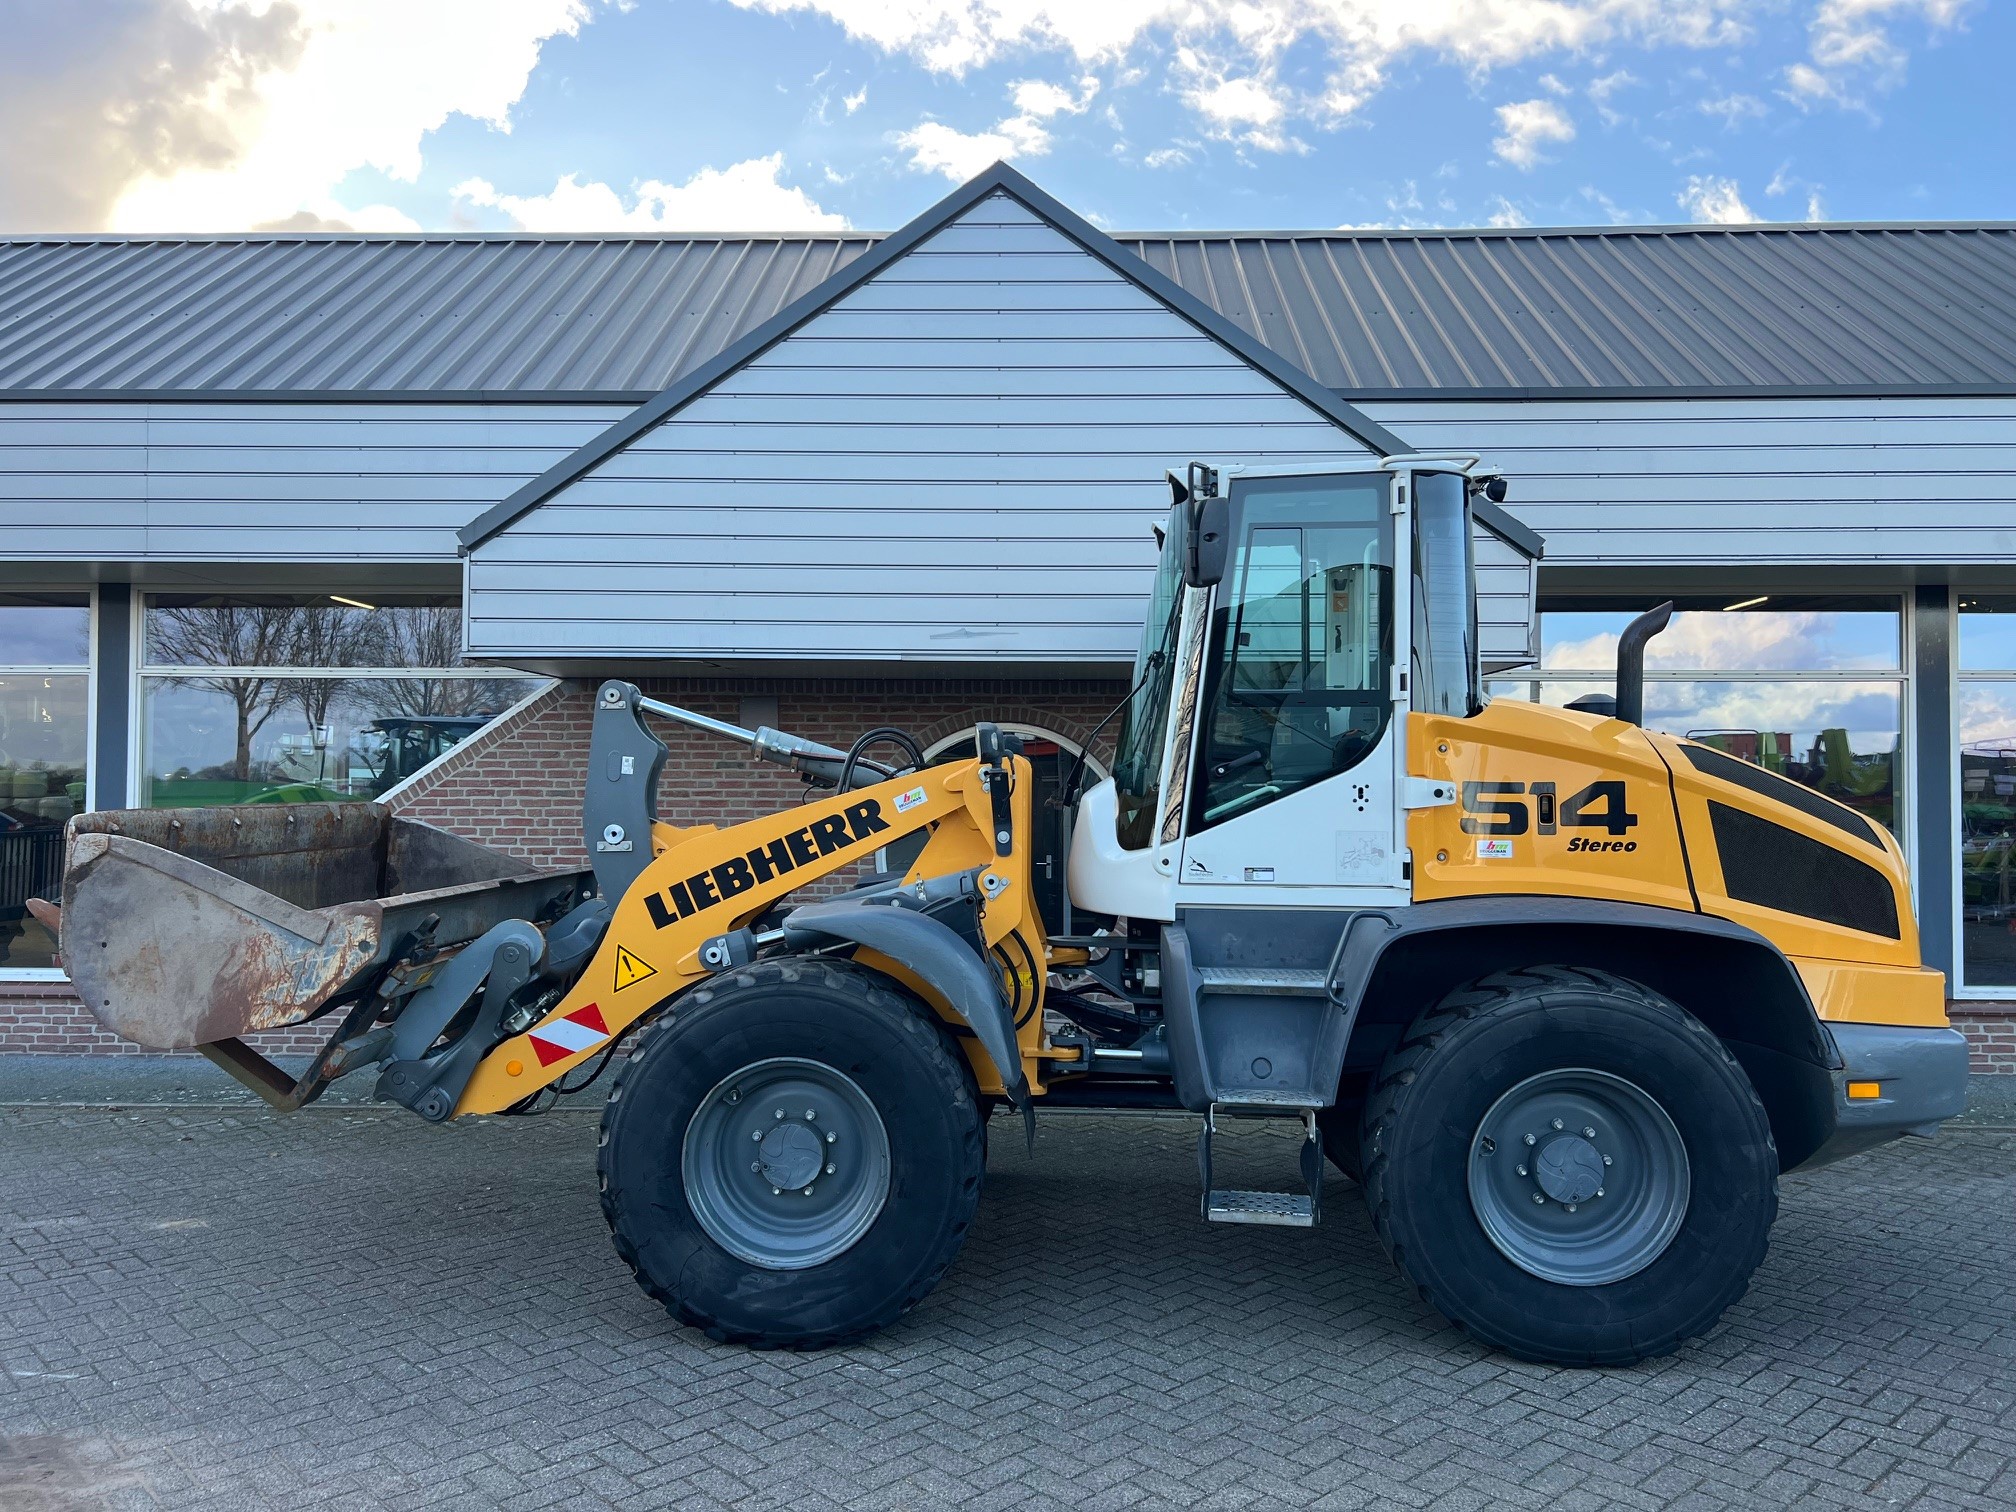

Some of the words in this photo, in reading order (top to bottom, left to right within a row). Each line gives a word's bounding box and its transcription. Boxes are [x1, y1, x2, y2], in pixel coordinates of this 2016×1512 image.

[1460, 781, 1638, 835] 514
[643, 798, 891, 931] LIEBHERR
[1567, 837, 1638, 852] Stereo
